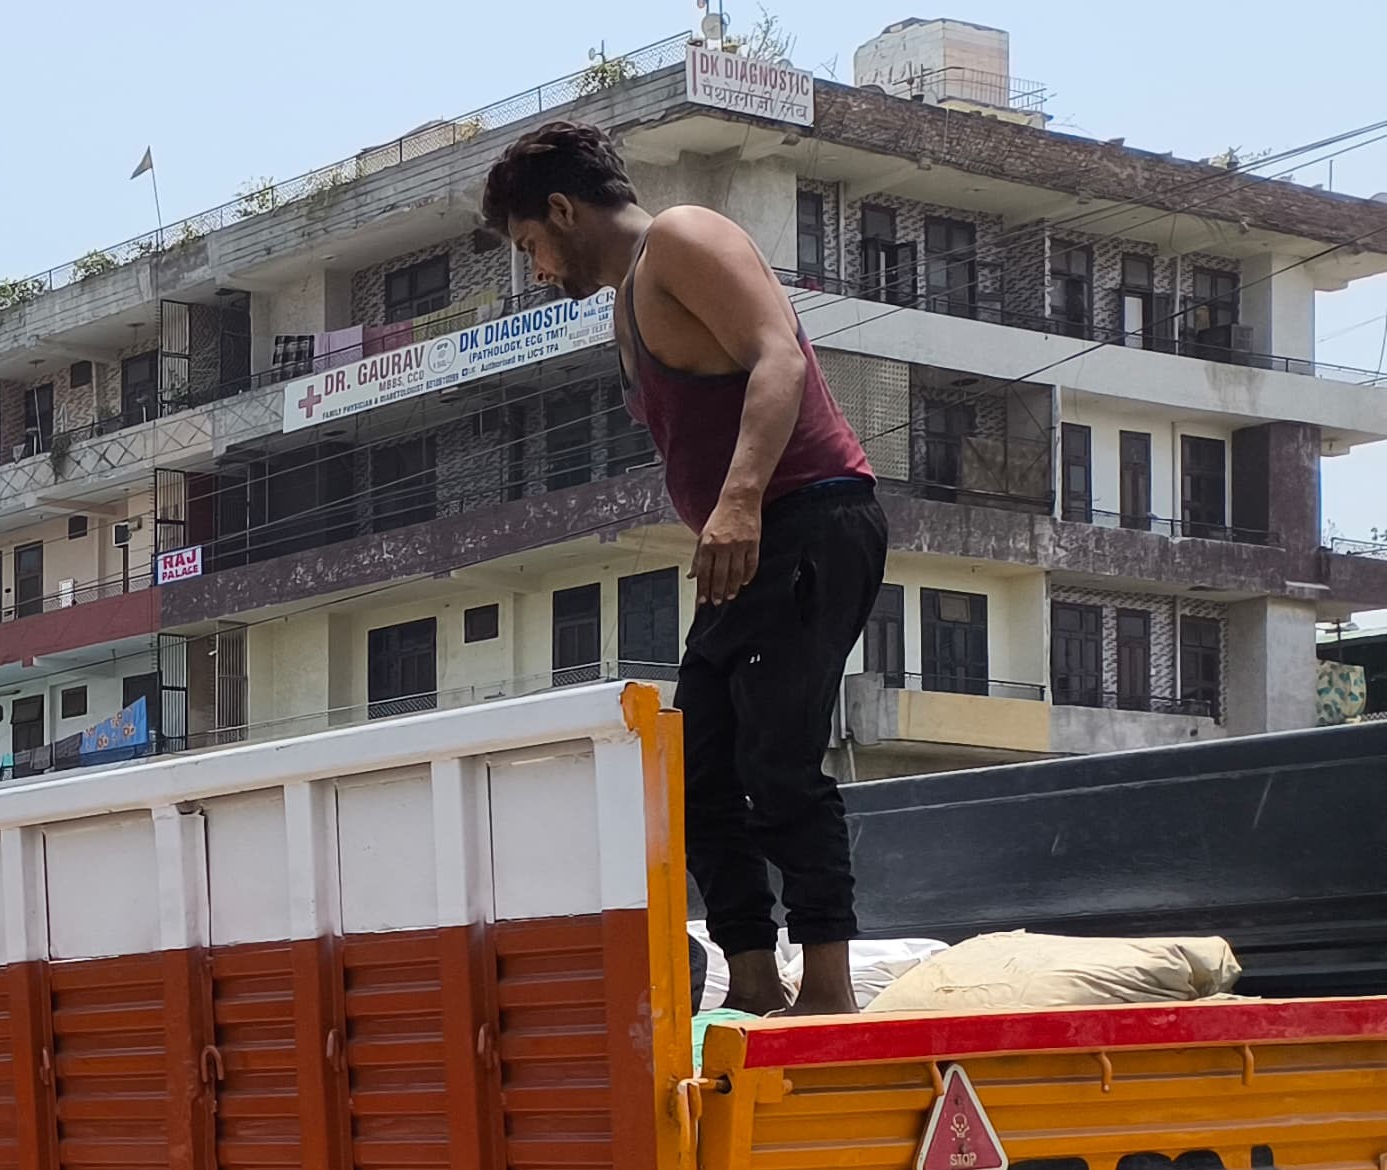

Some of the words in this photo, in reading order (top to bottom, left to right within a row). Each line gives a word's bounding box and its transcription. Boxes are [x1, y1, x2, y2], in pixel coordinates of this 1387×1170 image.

[700, 52, 719, 77] DK
[725, 58, 810, 96] DIAGNOSTIC
[459, 328, 479, 353] DK
[484, 300, 580, 347] DIAGNOSTIC
[525, 334, 543, 348] ECG
[546, 325, 568, 343] TMT)
[517, 351, 526, 364] by
[324, 369, 352, 397] DR.
[357, 344, 426, 387] GAURAV
[163, 549, 196, 570] RAJ
[162, 564, 199, 581] PALACE
[949, 1152, 977, 1167] STOP
